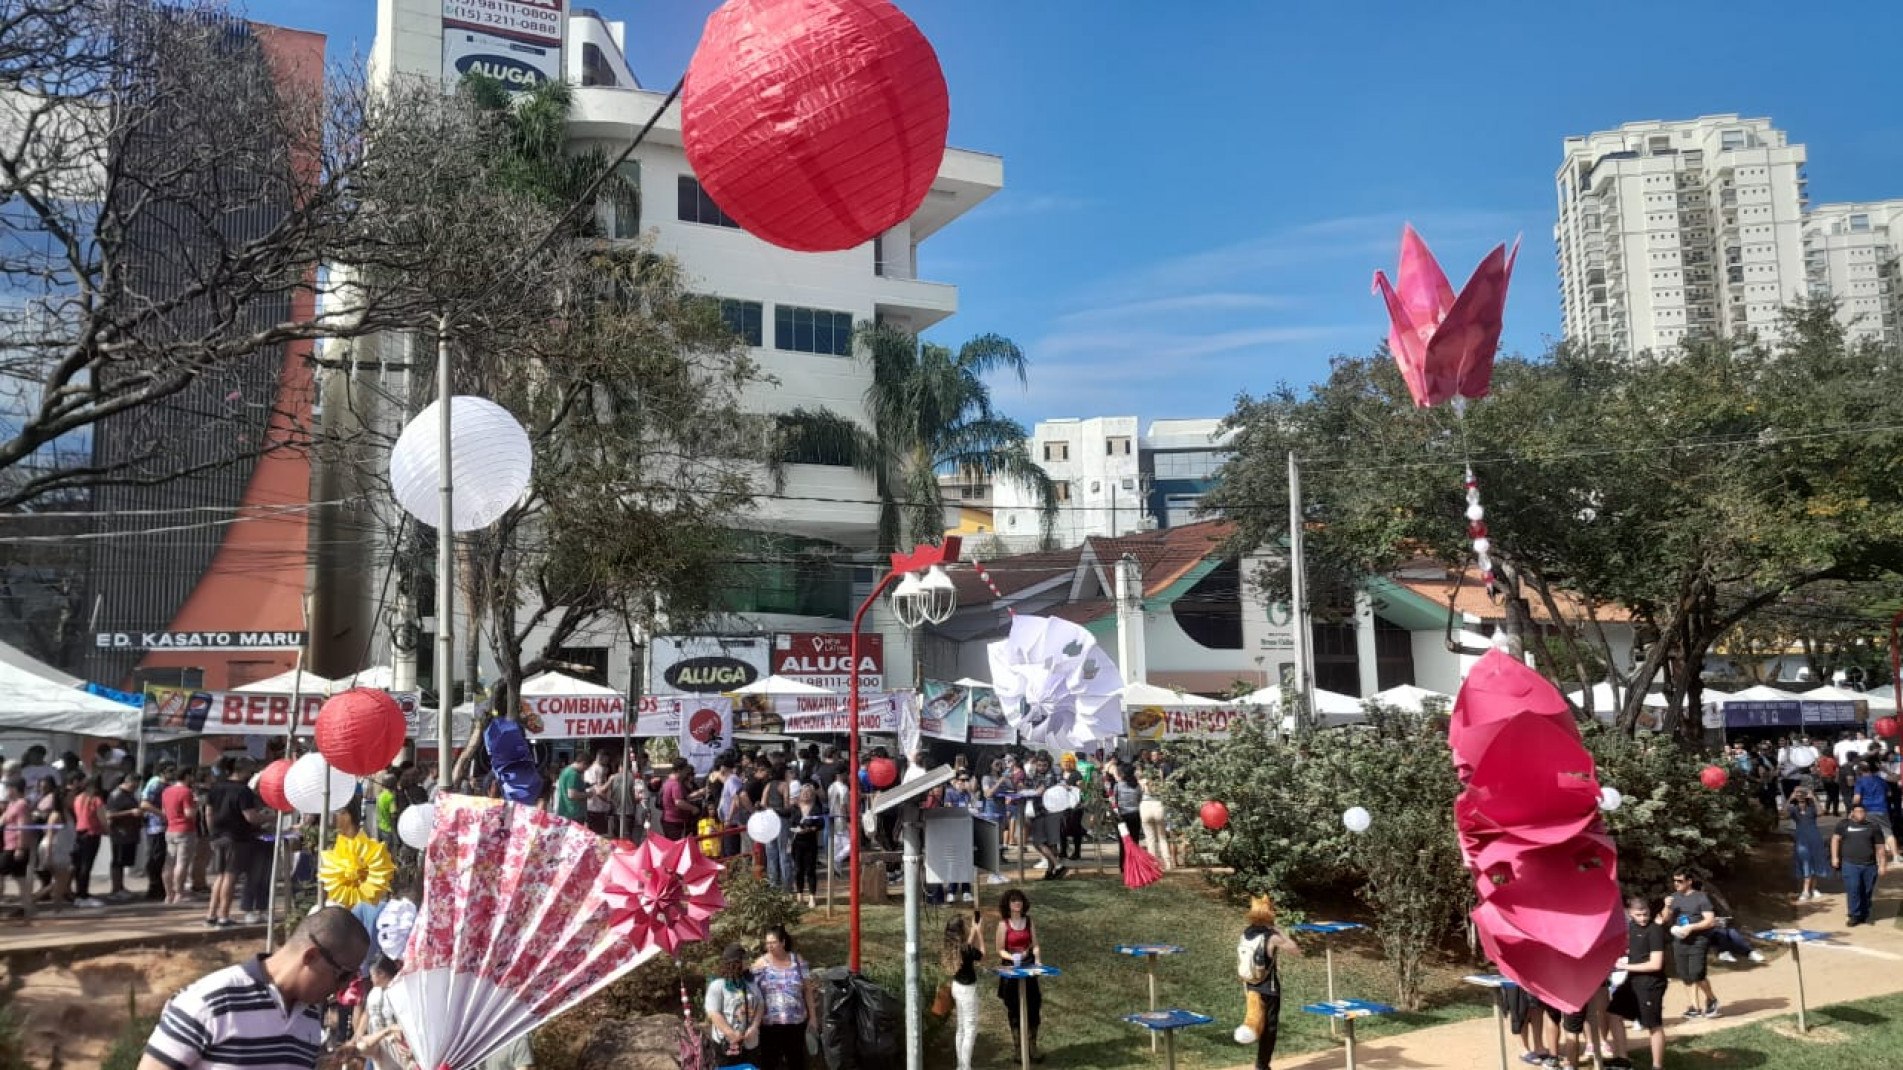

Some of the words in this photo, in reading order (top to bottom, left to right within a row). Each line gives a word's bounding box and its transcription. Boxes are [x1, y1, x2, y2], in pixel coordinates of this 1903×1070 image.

[454, 6, 480, 21] (15)
[468, 60, 536, 85] ALUGA
[96, 632, 131, 647] ED.
[142, 632, 230, 646] KASATO
[239, 632, 300, 646] MARU
[781, 656, 877, 671] ALUGA
[677, 666, 746, 684] ALUGA
[537, 696, 658, 714] COMBINAOS
